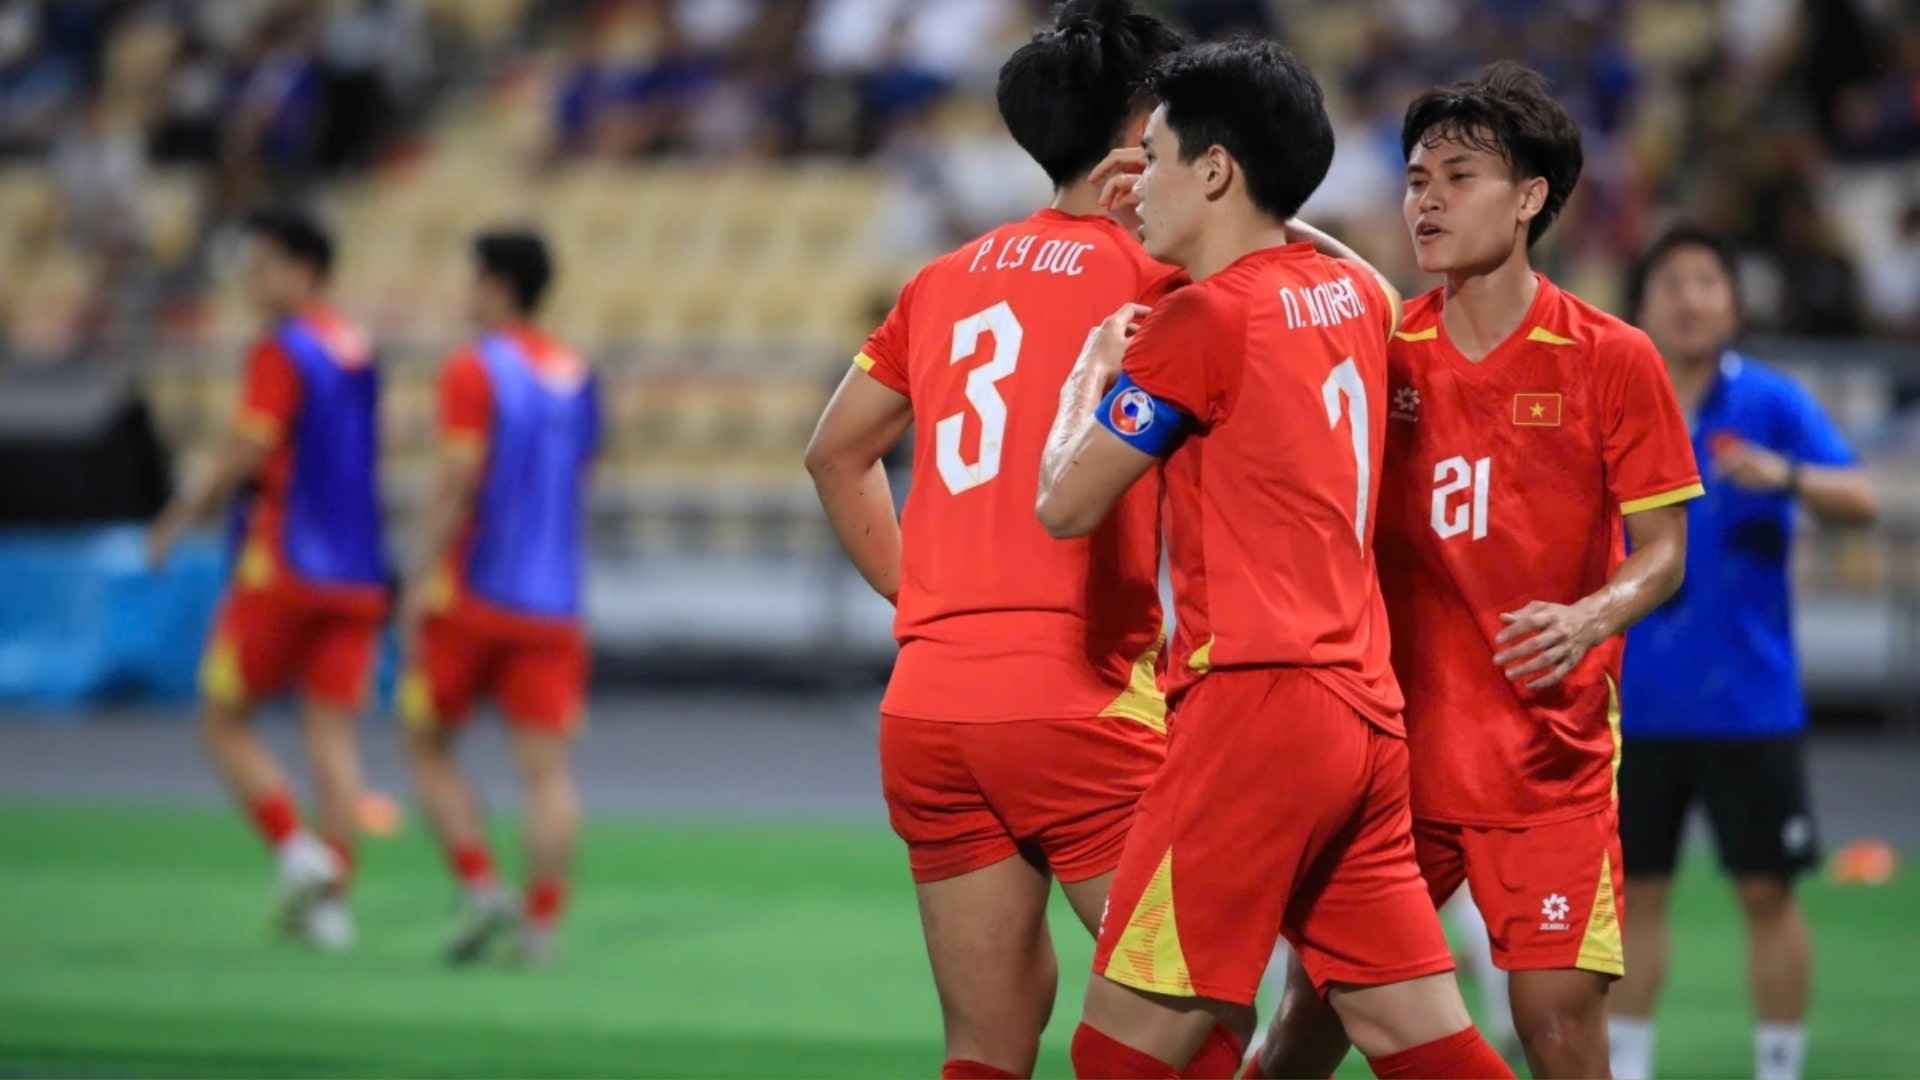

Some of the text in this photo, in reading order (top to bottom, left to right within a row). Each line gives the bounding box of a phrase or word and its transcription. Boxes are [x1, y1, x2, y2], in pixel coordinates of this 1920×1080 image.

[968, 235, 1095, 276] P. LY DUC
[935, 300, 1023, 496] 3
[1321, 356, 1369, 558] 7
[1430, 455, 1491, 541] 21
